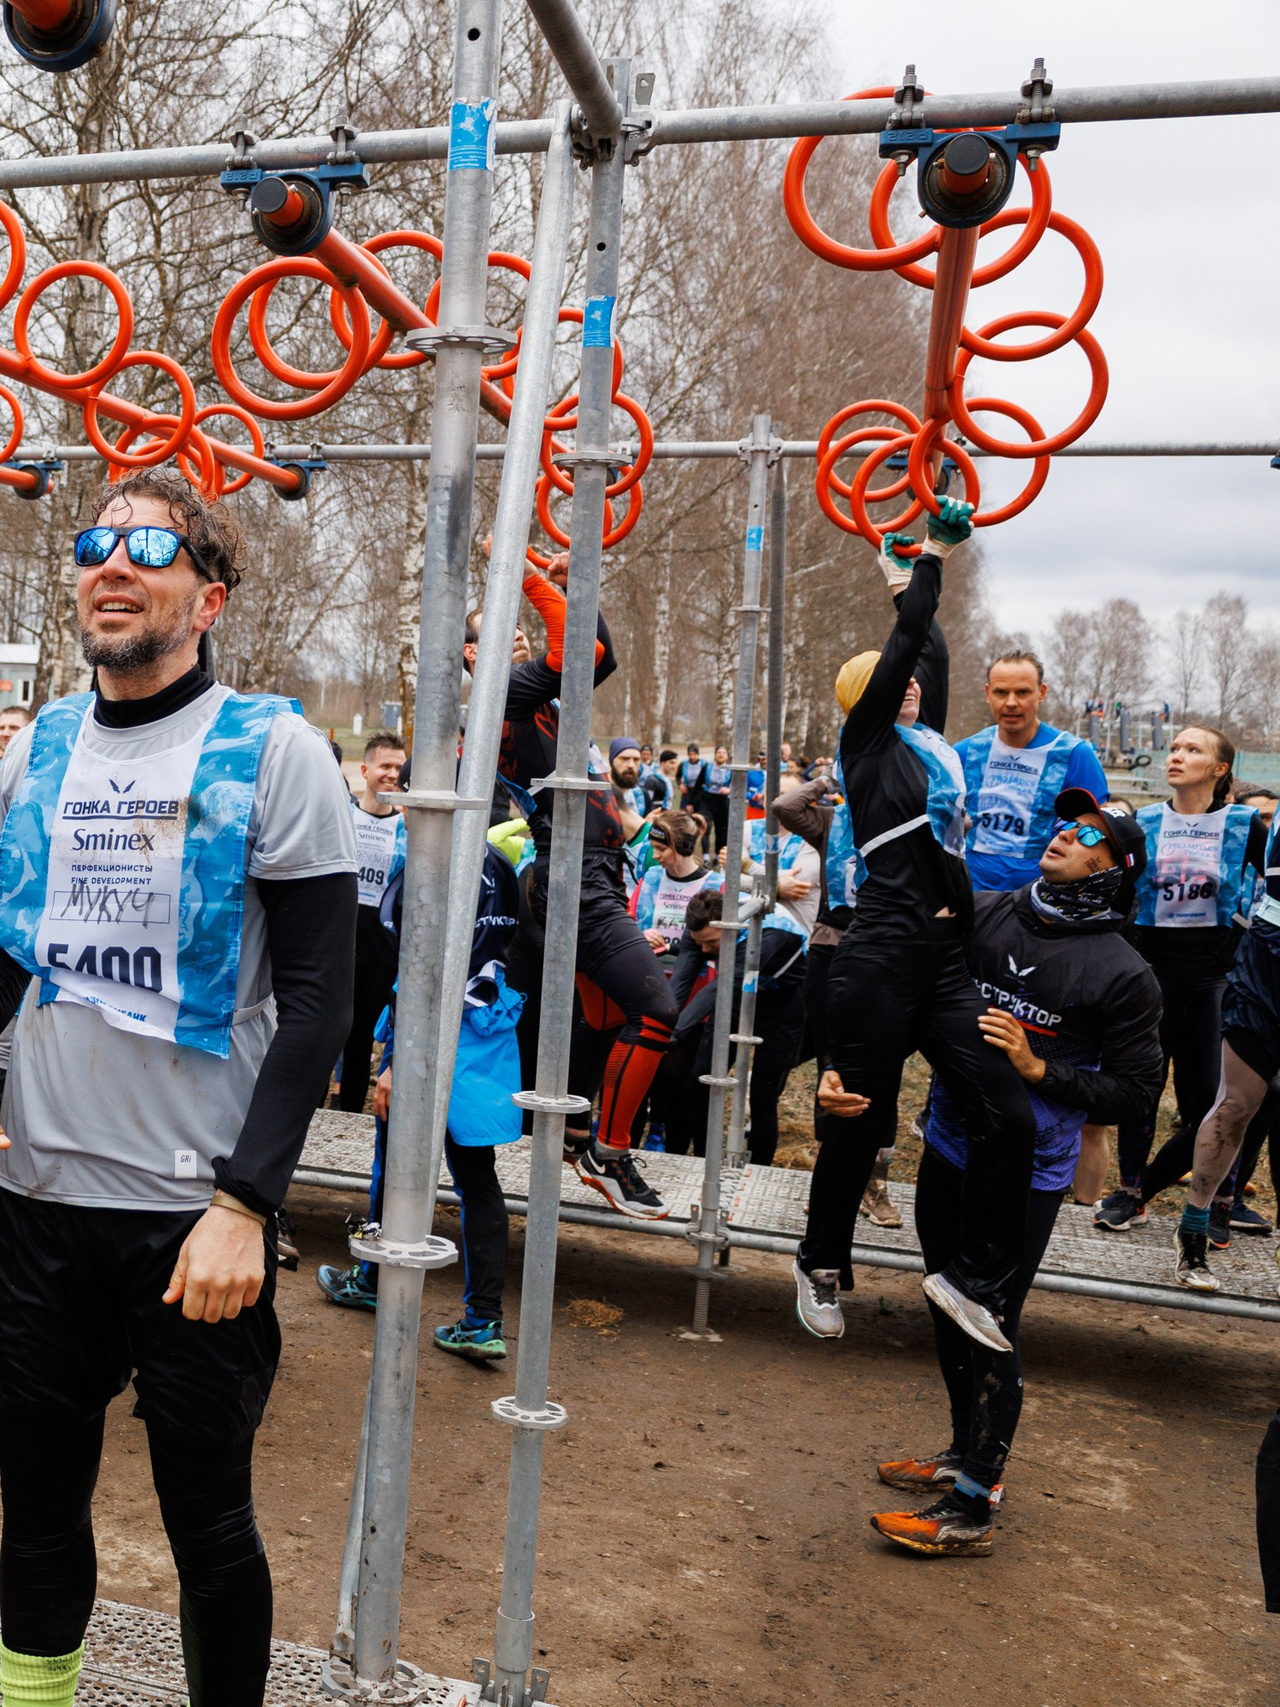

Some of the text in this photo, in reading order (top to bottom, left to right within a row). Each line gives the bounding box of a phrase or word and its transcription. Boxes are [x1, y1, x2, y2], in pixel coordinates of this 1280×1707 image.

[63, 800, 179, 815] ГОНКА ГЕРОЕВ
[982, 812, 1025, 836] 5179
[72, 828, 155, 851] Sminex
[71, 864, 153, 873] ПЕРФЕКЦИОНИСТЫ
[71, 877, 151, 885] FINE DEVELOPMENT
[1163, 881, 1213, 902] 5186
